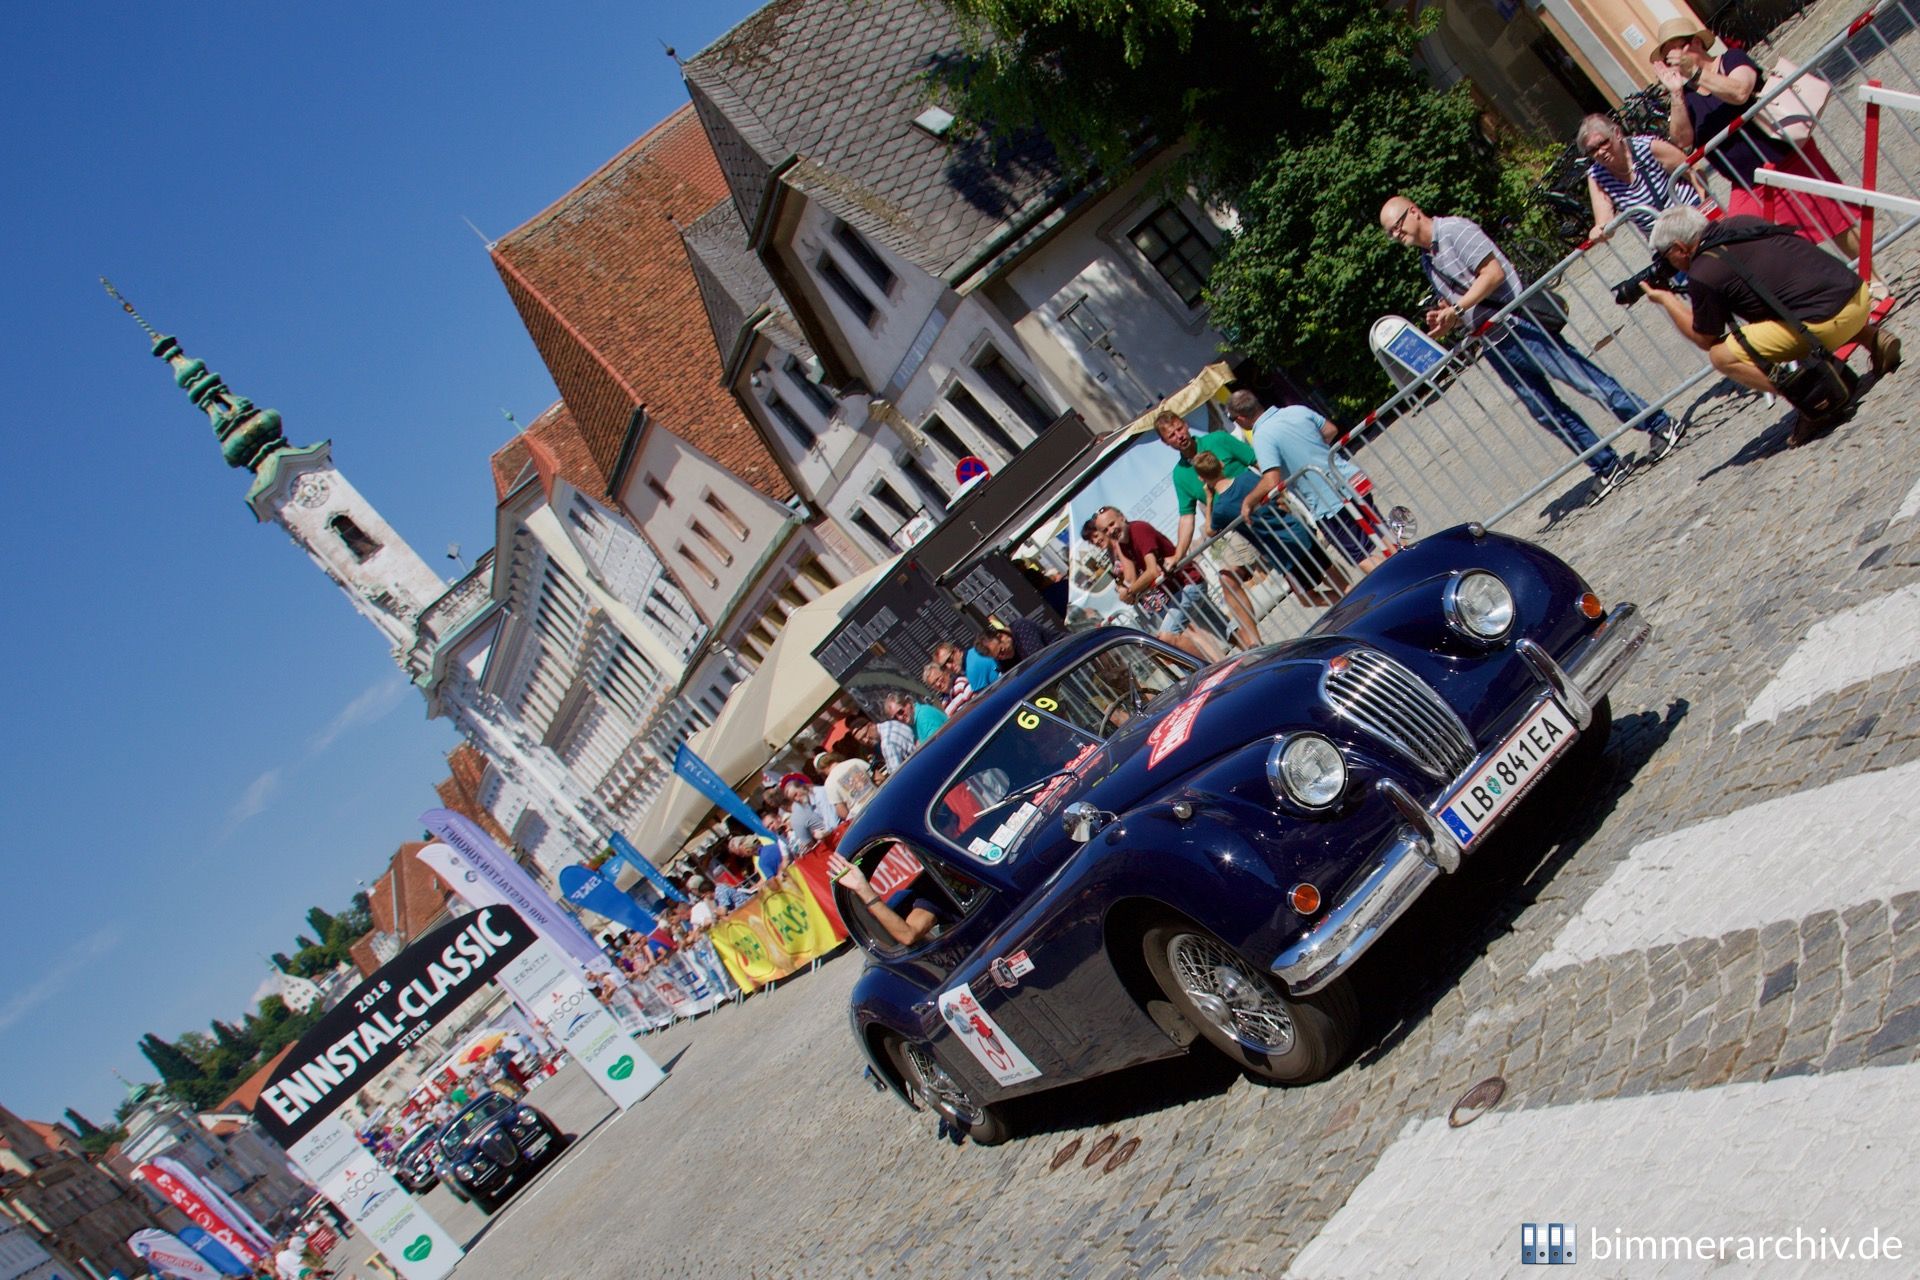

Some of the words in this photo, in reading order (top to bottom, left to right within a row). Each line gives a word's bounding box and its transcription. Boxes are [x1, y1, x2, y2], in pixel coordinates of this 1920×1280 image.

[1016, 696, 1059, 730] 69
[1460, 785, 1494, 823] LB
[1496, 717, 1563, 786] 841EA
[1459, 828, 1469, 838] A
[513, 953, 549, 985] ZENITH
[354, 979, 392, 1014] 2018
[548, 987, 590, 1024] HISCOX
[260, 908, 513, 1127] ENNSTAL-CLASSIC
[397, 1019, 433, 1050] STEYR
[303, 1129, 343, 1163] ZENITH
[336, 1163, 385, 1206] HISCOX
